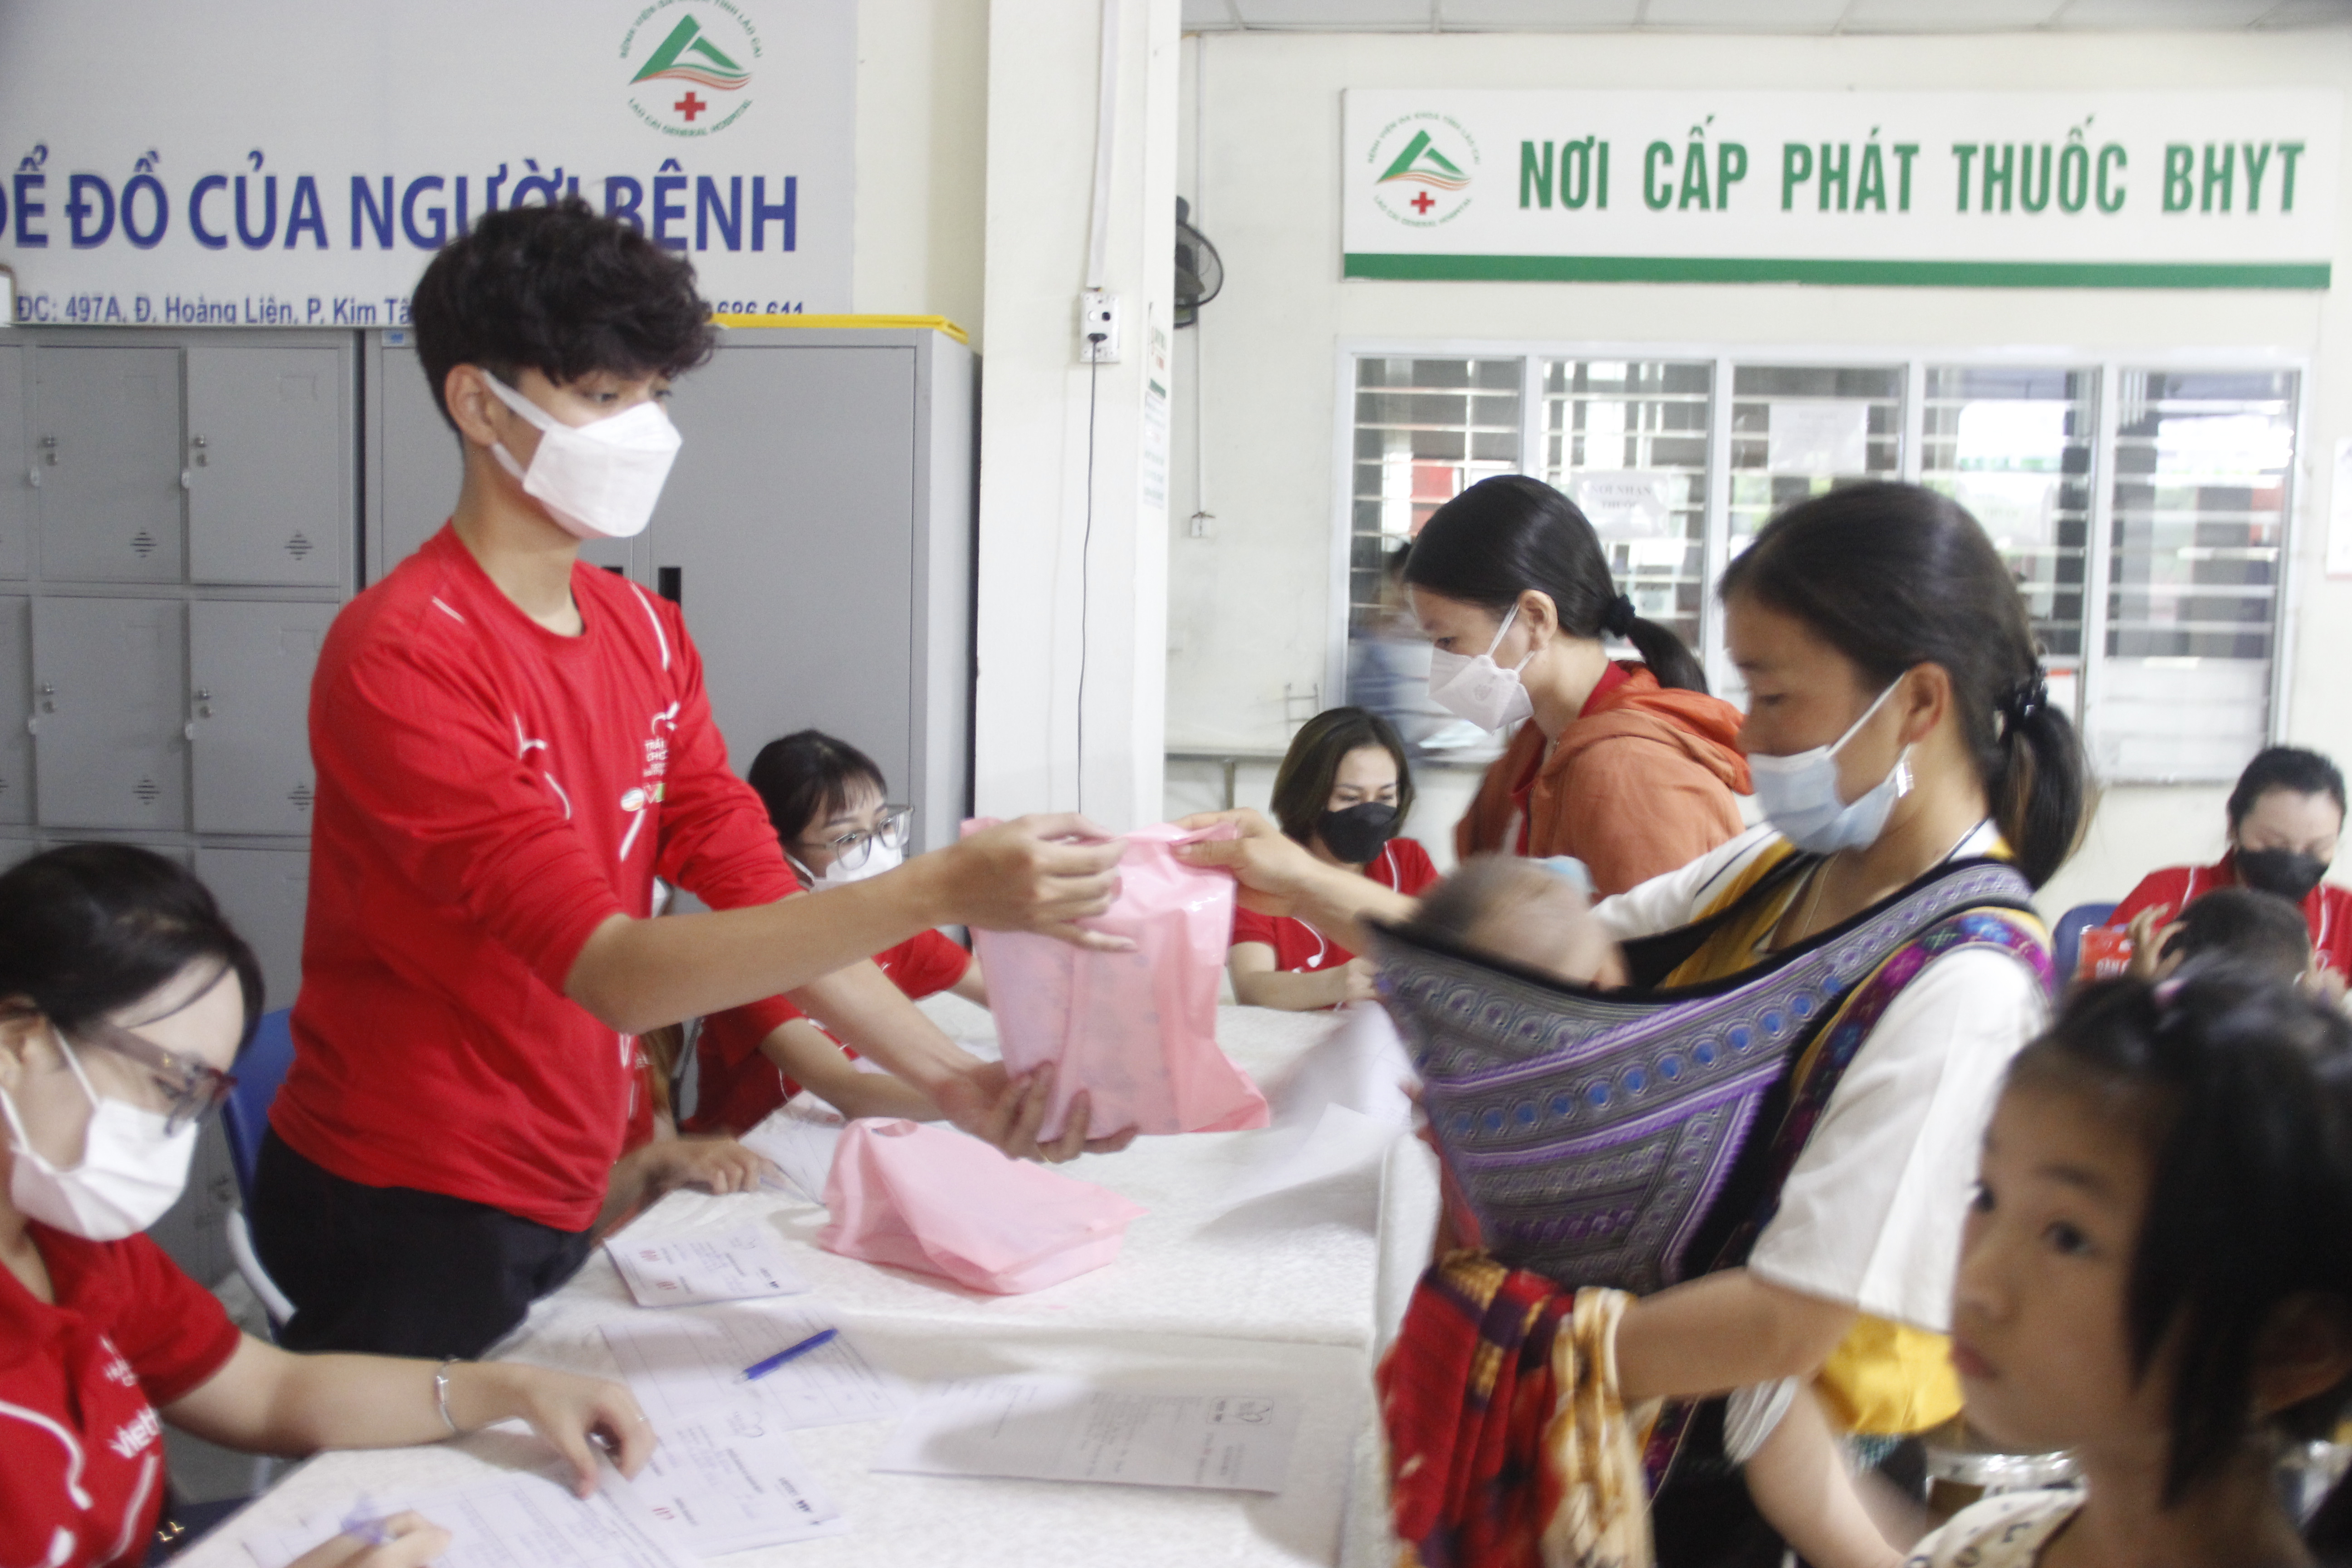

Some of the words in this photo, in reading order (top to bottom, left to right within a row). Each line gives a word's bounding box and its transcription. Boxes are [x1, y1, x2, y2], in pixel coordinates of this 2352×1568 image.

[0, 144, 49, 249] Ể
[65, 151, 169, 250] ĐỒ
[188, 150, 329, 250] CỦA
[1519, 134, 1609, 210] NƠI
[1643, 115, 1749, 211] CẤP
[1782, 126, 1920, 211] PHÁT
[1952, 113, 2128, 214] THUỐC
[2162, 143, 2305, 214] BHYT
[17, 295, 58, 322] ĐC:
[333, 297, 377, 325] Kim
